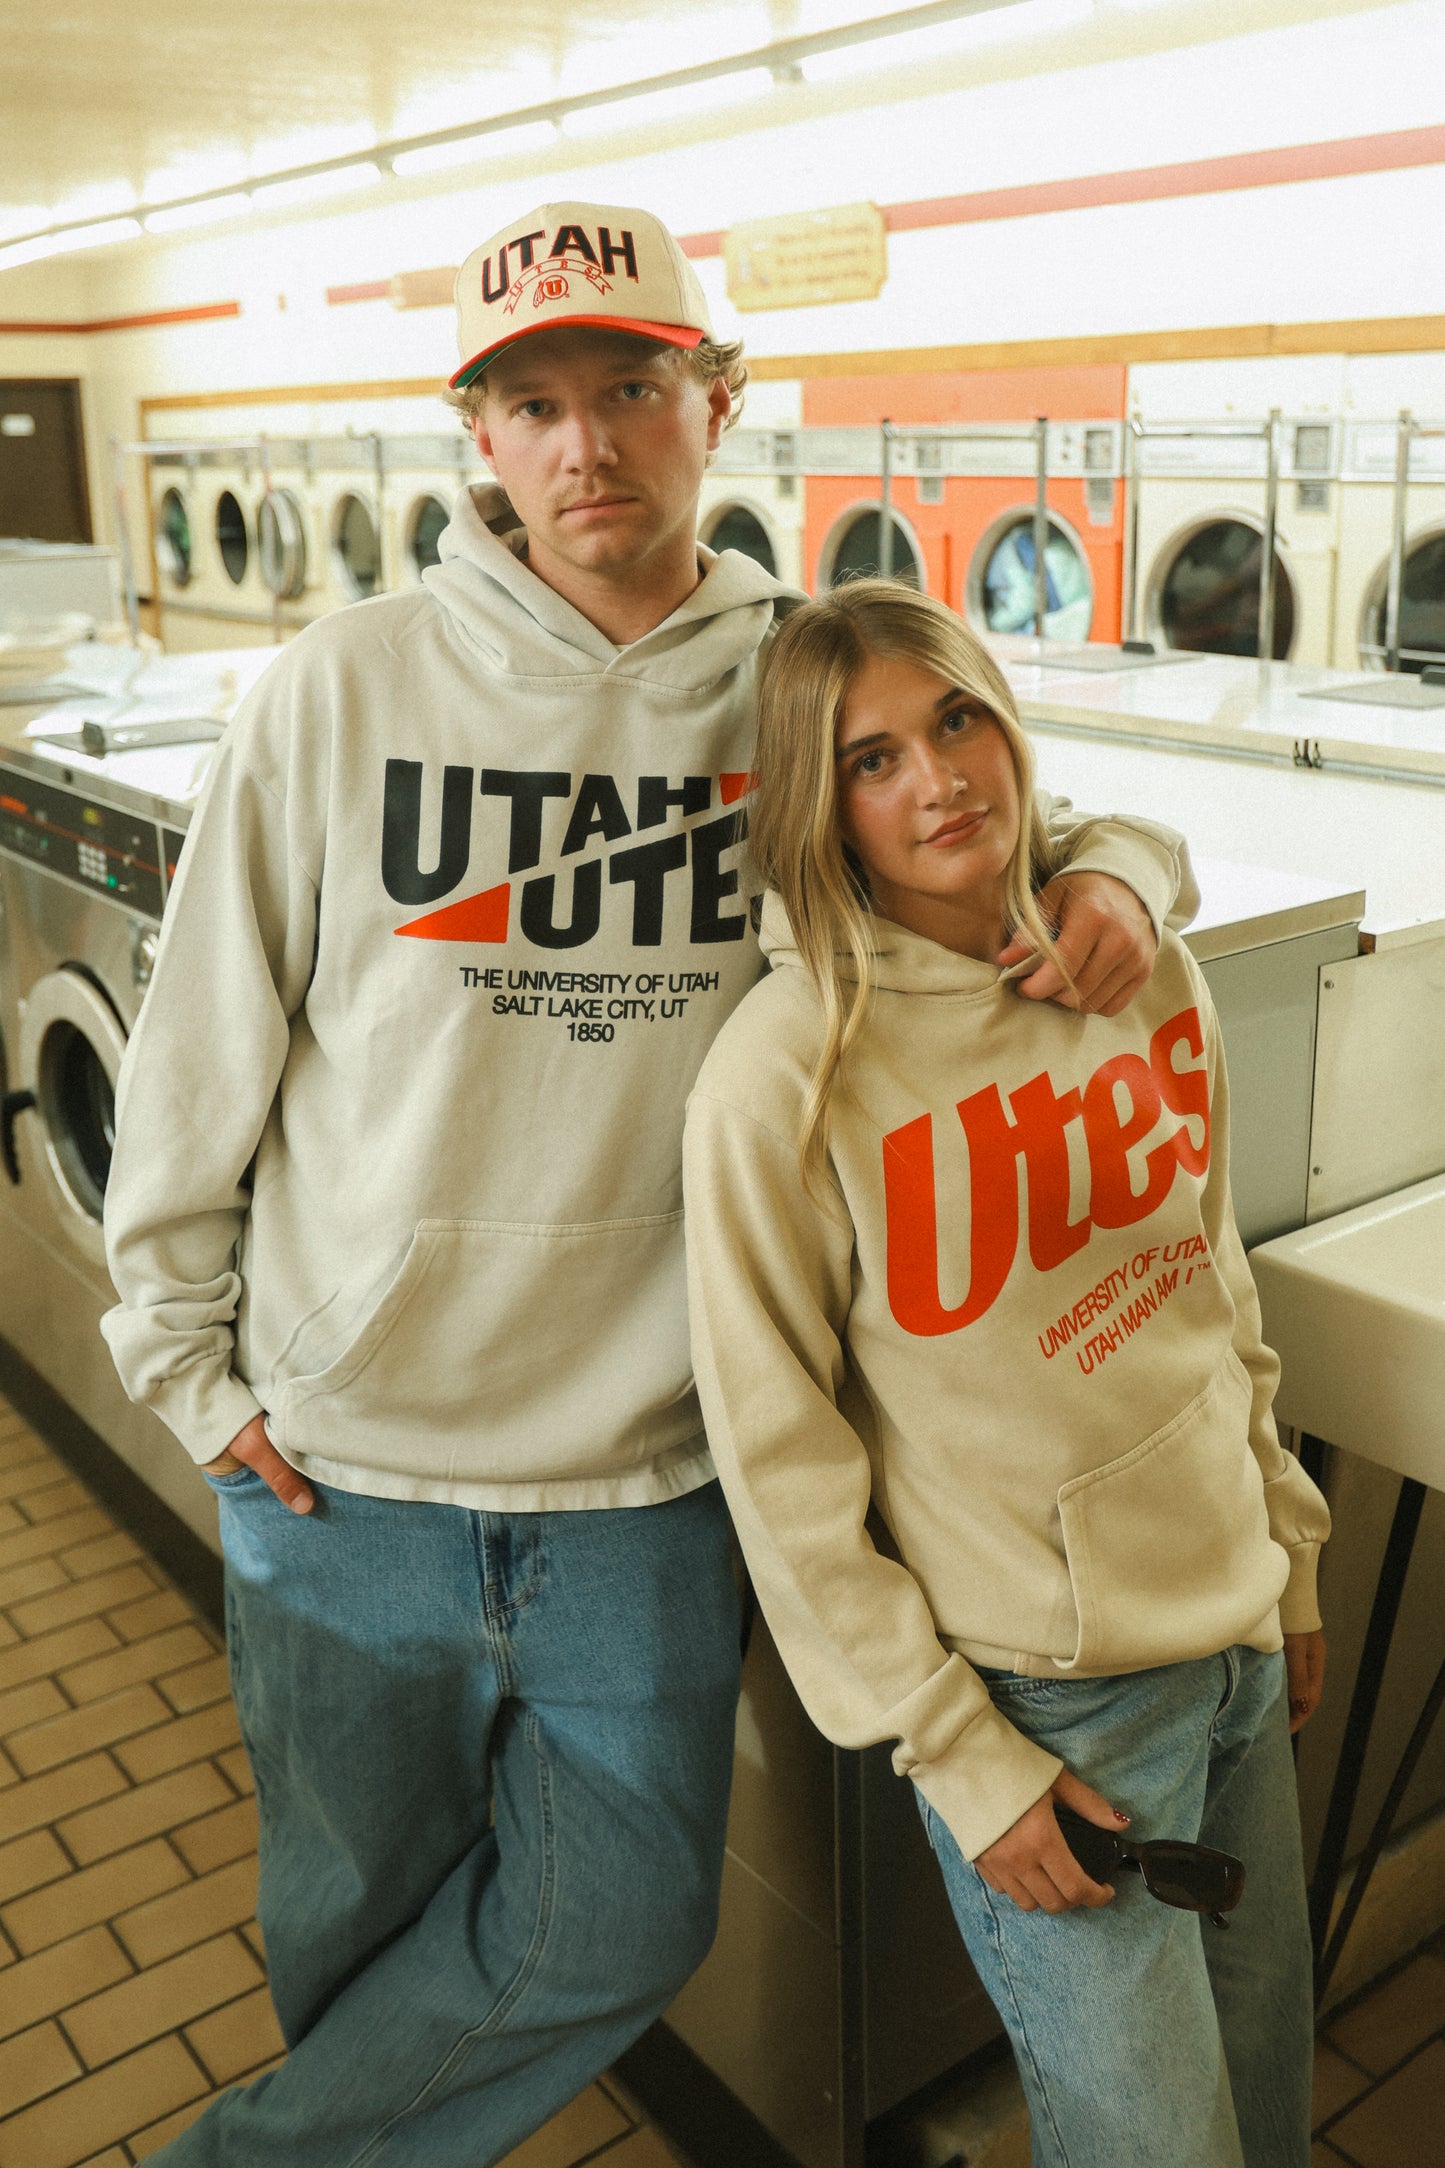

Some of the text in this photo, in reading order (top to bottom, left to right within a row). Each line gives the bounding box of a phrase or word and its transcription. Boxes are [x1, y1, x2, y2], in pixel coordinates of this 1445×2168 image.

[482, 225, 638, 304] UTAH
[545, 279, 563, 296] U
[381, 758, 712, 906] UTAH
[459, 967, 719, 994] THE UNIVERSITY OF UTAH
[492, 995, 688, 1022] SALT LAKE CITY, UT
[566, 1022, 615, 1043] 1850
[882, 1006, 1211, 1337] Utes
[1038, 1262, 1128, 1359] UNIVERSITY
[1131, 1247, 1160, 1280] OF
[1076, 1319, 1125, 1375] UTAH
[1119, 1286, 1158, 1337] MAN
[1154, 1268, 1179, 1306] AM
